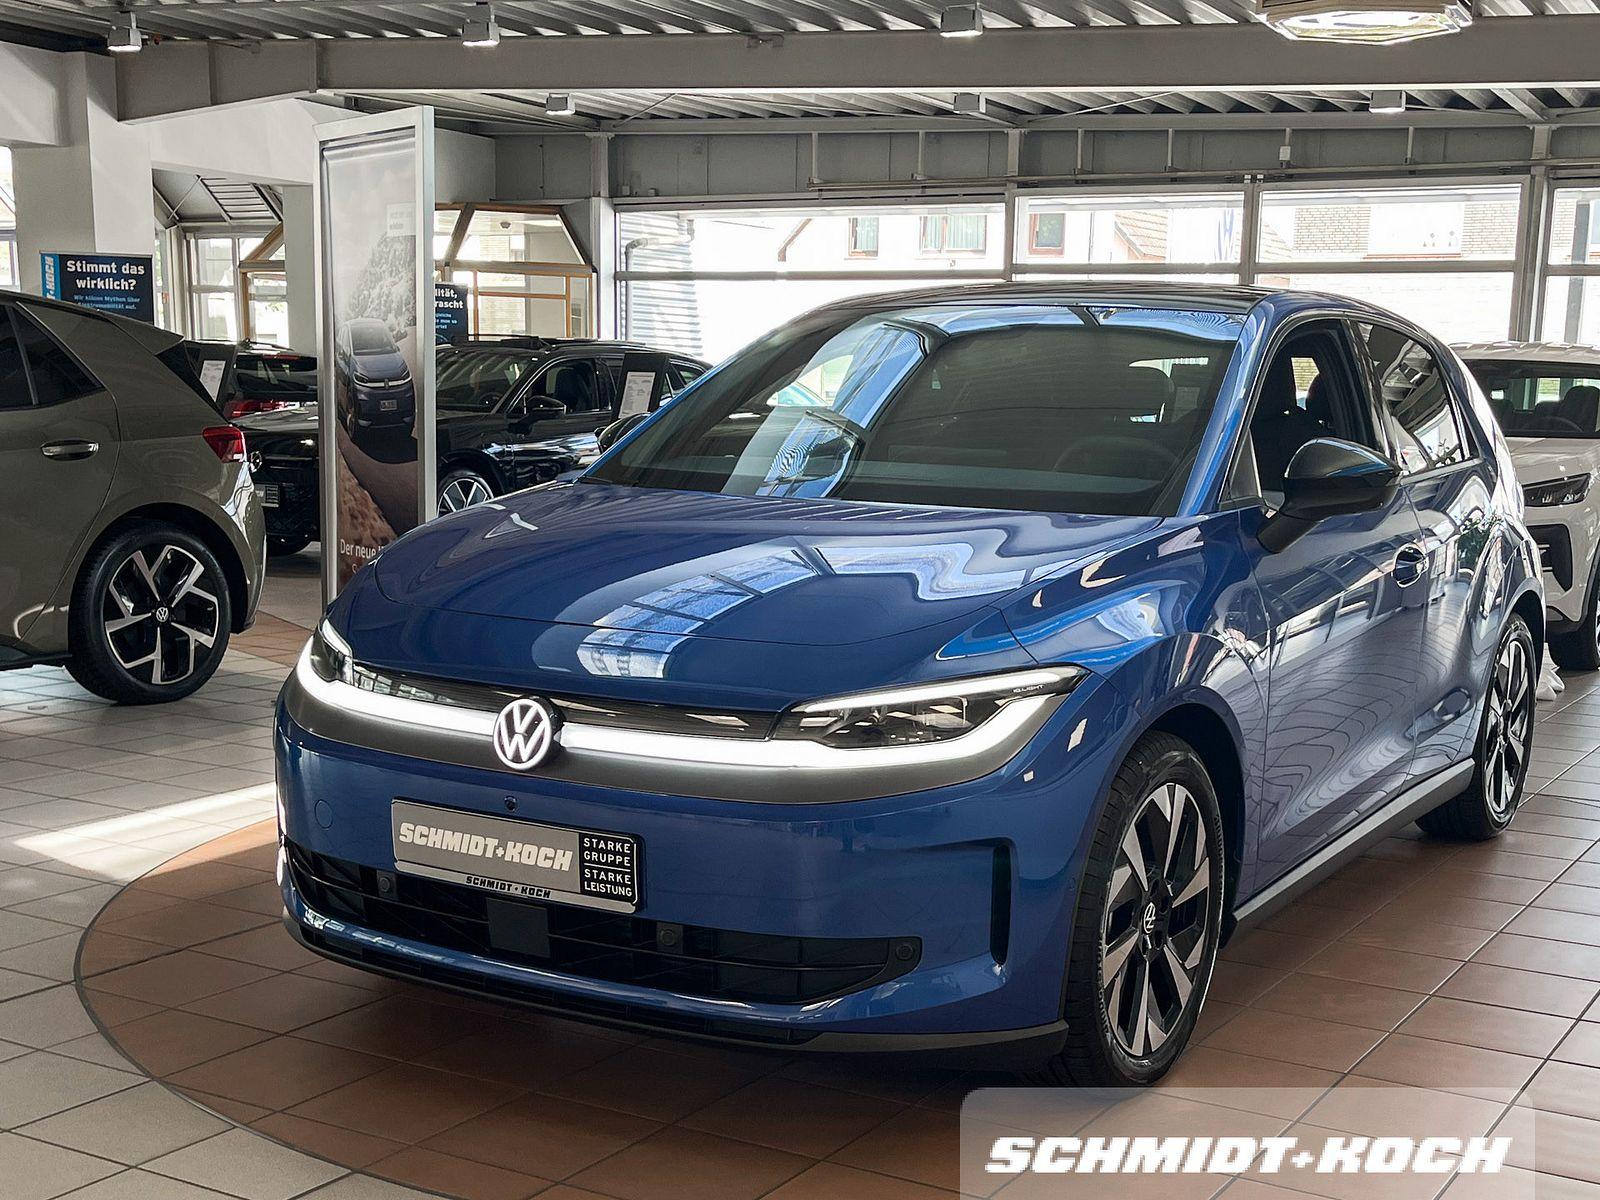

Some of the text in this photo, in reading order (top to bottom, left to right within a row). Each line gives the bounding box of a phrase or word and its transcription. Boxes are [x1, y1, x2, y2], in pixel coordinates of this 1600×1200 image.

[66, 260, 145, 275] Stimmt das
[75, 277, 137, 290] wirklich?
[340, 539, 354, 556] Der
[399, 822, 573, 872] SCHMIDT+KOCH
[583, 837, 631, 853] STARKE
[583, 850, 631, 867] GRUPPE
[584, 868, 632, 885] STARKE
[465, 875, 513, 892] SCHMIDT
[520, 885, 552, 899] KOCH
[584, 881, 633, 897] LEISTUNG
